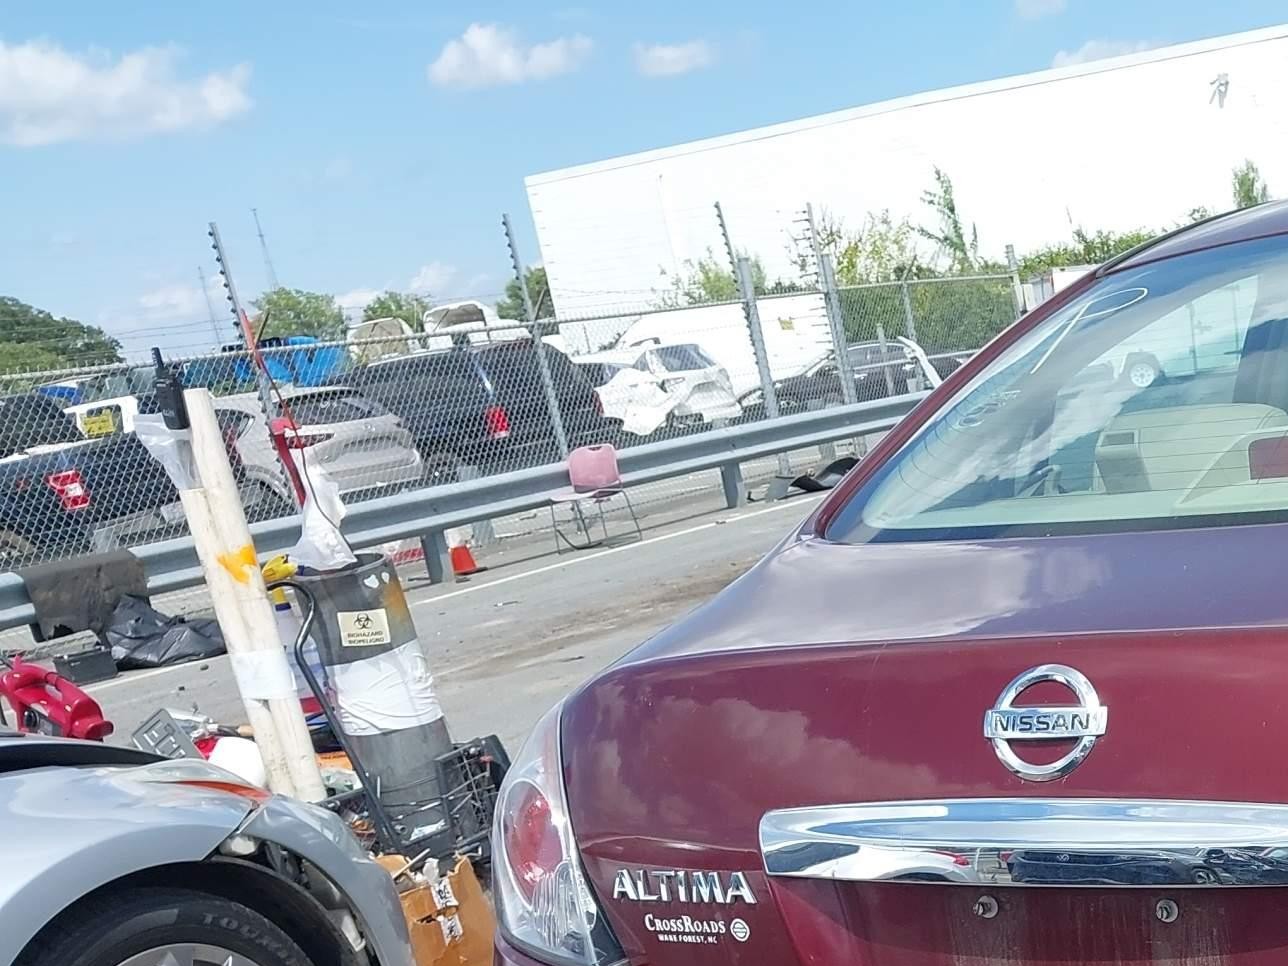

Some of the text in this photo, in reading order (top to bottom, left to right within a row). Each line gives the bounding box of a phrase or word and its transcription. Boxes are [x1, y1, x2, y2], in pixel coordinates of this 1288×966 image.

[994, 713, 1090, 732] NISSAN
[613, 868, 758, 904] ALTIMA
[657, 934, 678, 942] WAKE
[708, 936, 718, 944] NC
